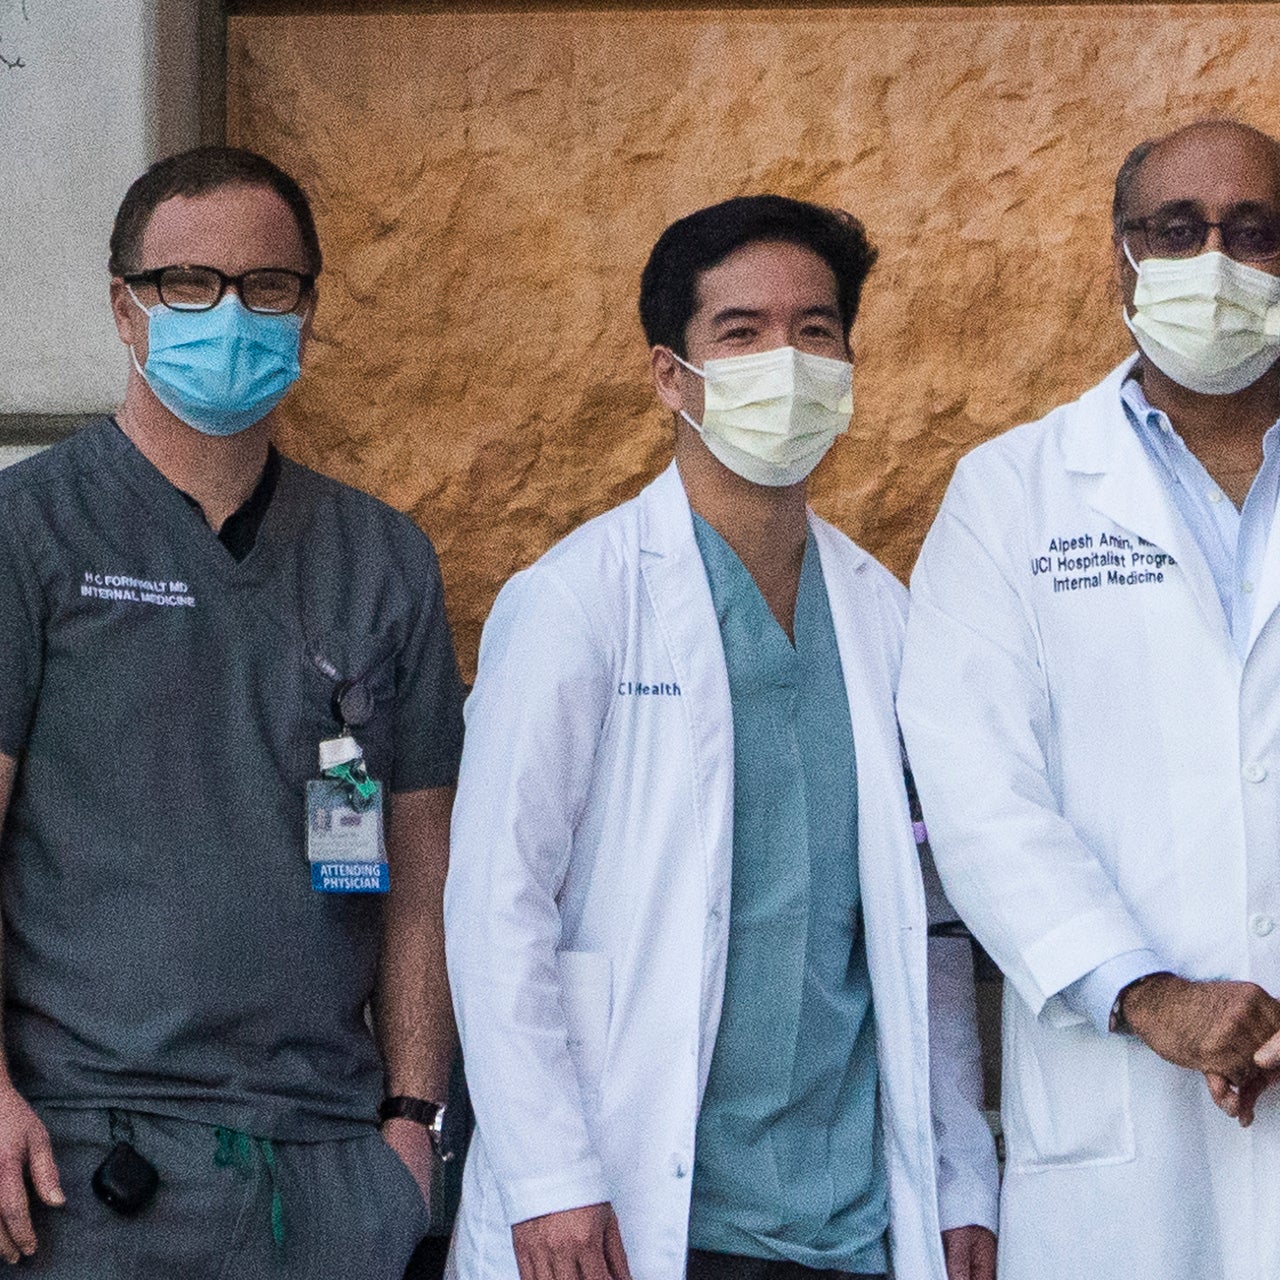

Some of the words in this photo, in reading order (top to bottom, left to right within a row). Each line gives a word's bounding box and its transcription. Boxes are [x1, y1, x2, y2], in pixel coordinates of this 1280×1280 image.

[1048, 533, 1094, 555] Alpesh
[1099, 532, 1134, 551] Amin,
[1031, 556, 1052, 576] UCI
[1058, 551, 1126, 573] Hospitalist
[1131, 552, 1178, 569] Progra
[169, 580, 189, 593] MD
[1053, 572, 1102, 593] Internal
[1107, 569, 1165, 586] Medicine
[80, 585, 140, 602] INTERNAL
[140, 592, 196, 608] MEDICINE
[634, 681, 682, 697] Health
[320, 863, 381, 877] ATTENDING
[323, 877, 380, 890] PHYSICIAN
